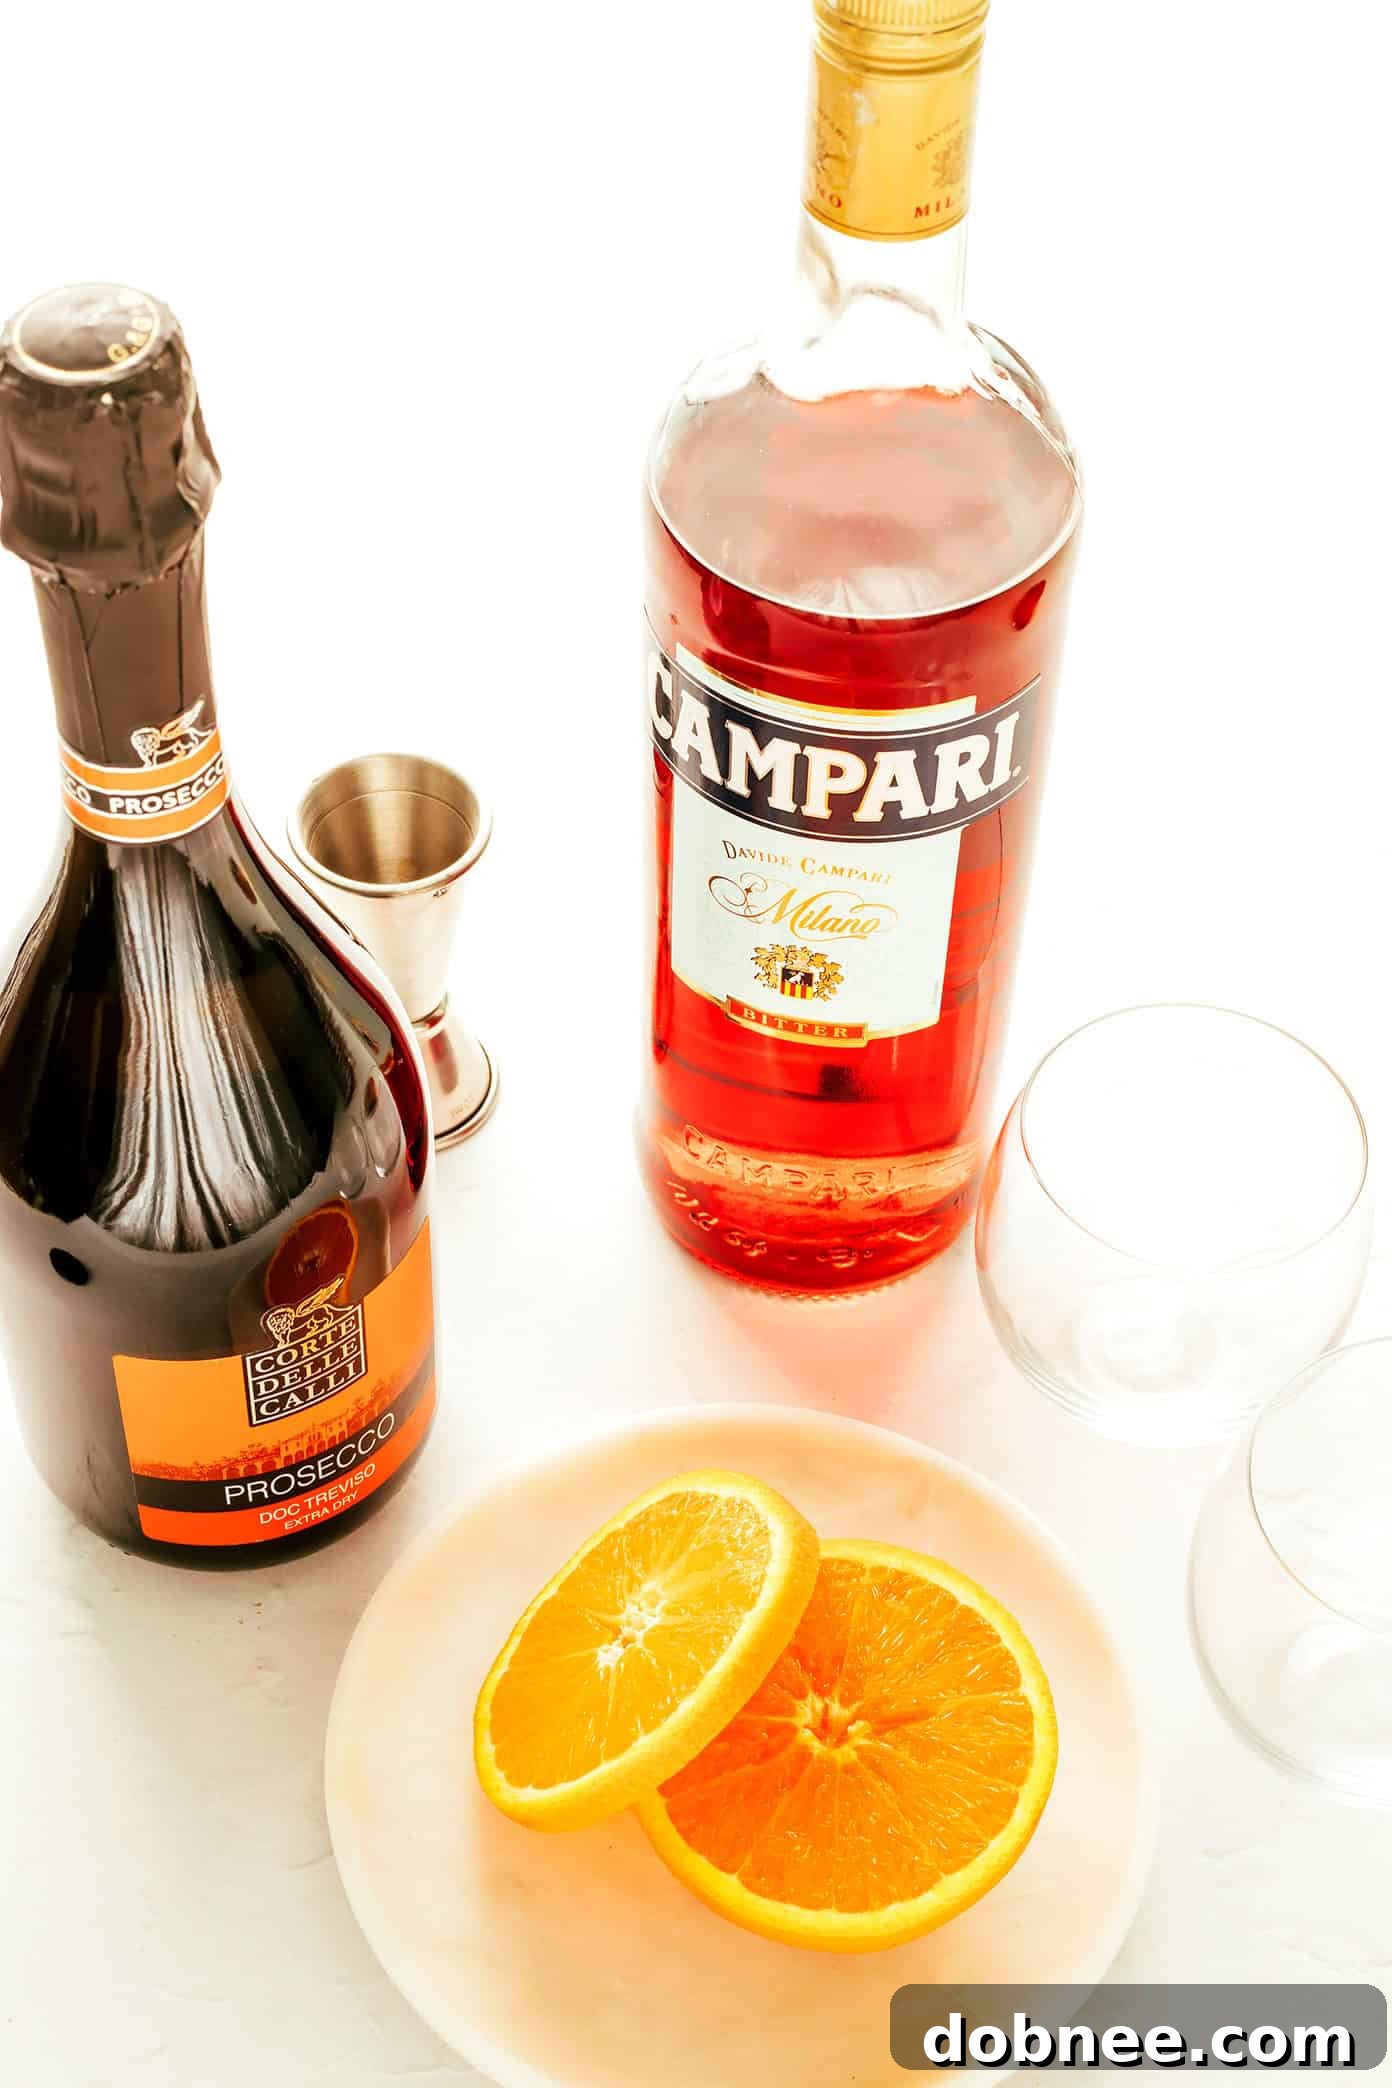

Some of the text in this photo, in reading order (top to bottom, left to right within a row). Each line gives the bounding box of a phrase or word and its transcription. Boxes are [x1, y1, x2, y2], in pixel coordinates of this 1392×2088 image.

[742, 1006, 849, 1038] BITTER
[254, 1314, 357, 1374] CORTE
[256, 1336, 358, 1397] DELLE
[259, 1361, 358, 1417] CALLI
[224, 1412, 396, 1506] PROSECCO
[259, 1462, 377, 1525] DOC TREVISO
[284, 1489, 360, 1531] EXTRA DRY
